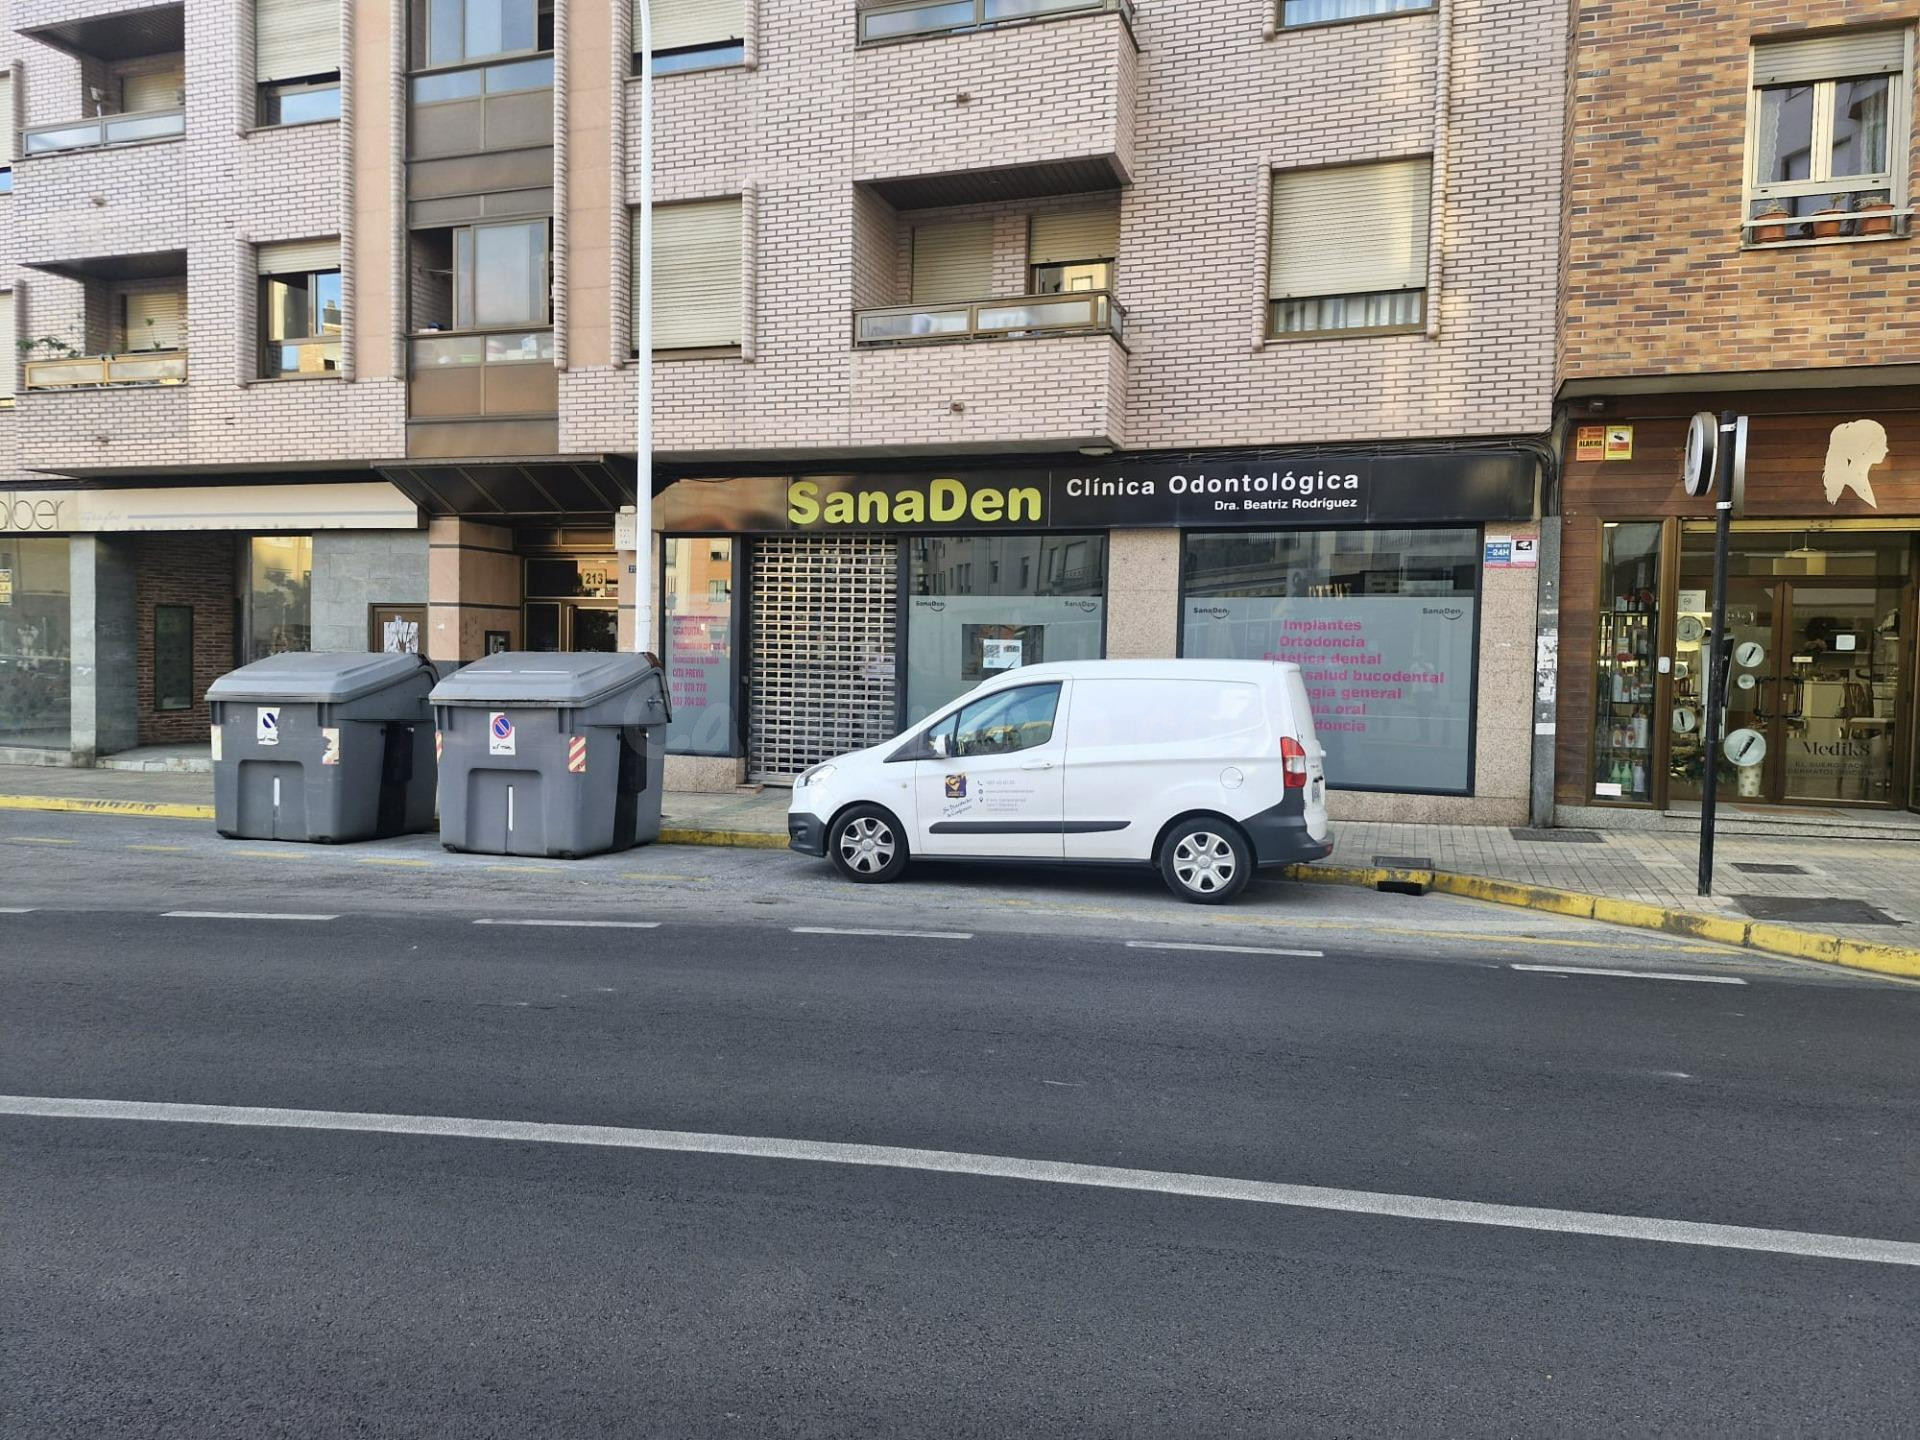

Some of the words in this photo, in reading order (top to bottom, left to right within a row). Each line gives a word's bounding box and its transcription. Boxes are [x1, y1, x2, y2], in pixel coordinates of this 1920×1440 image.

[1066, 477, 1155, 496] Clínica
[1168, 471, 1359, 495] Odontológica
[787, 478, 1042, 524] SanaDen
[1214, 500, 1240, 510] Dra.
[1244, 499, 1288, 510] Beatriz
[1292, 498, 1358, 510] Rodríguez
[585, 573, 603, 584] 213
[1193, 607, 1228, 615] SanaDen
[1422, 607, 1461, 615] SanaDen
[1283, 620, 1362, 633] Implantes
[1279, 636, 1366, 648] Ortodoncia
[1330, 652, 1382, 665] dental
[1305, 669, 1348, 682] salud
[1353, 670, 1445, 684] bucodental
[1341, 688, 1402, 701] general
[1335, 704, 1366, 715] oral
[1803, 741, 1870, 756] Medik8
